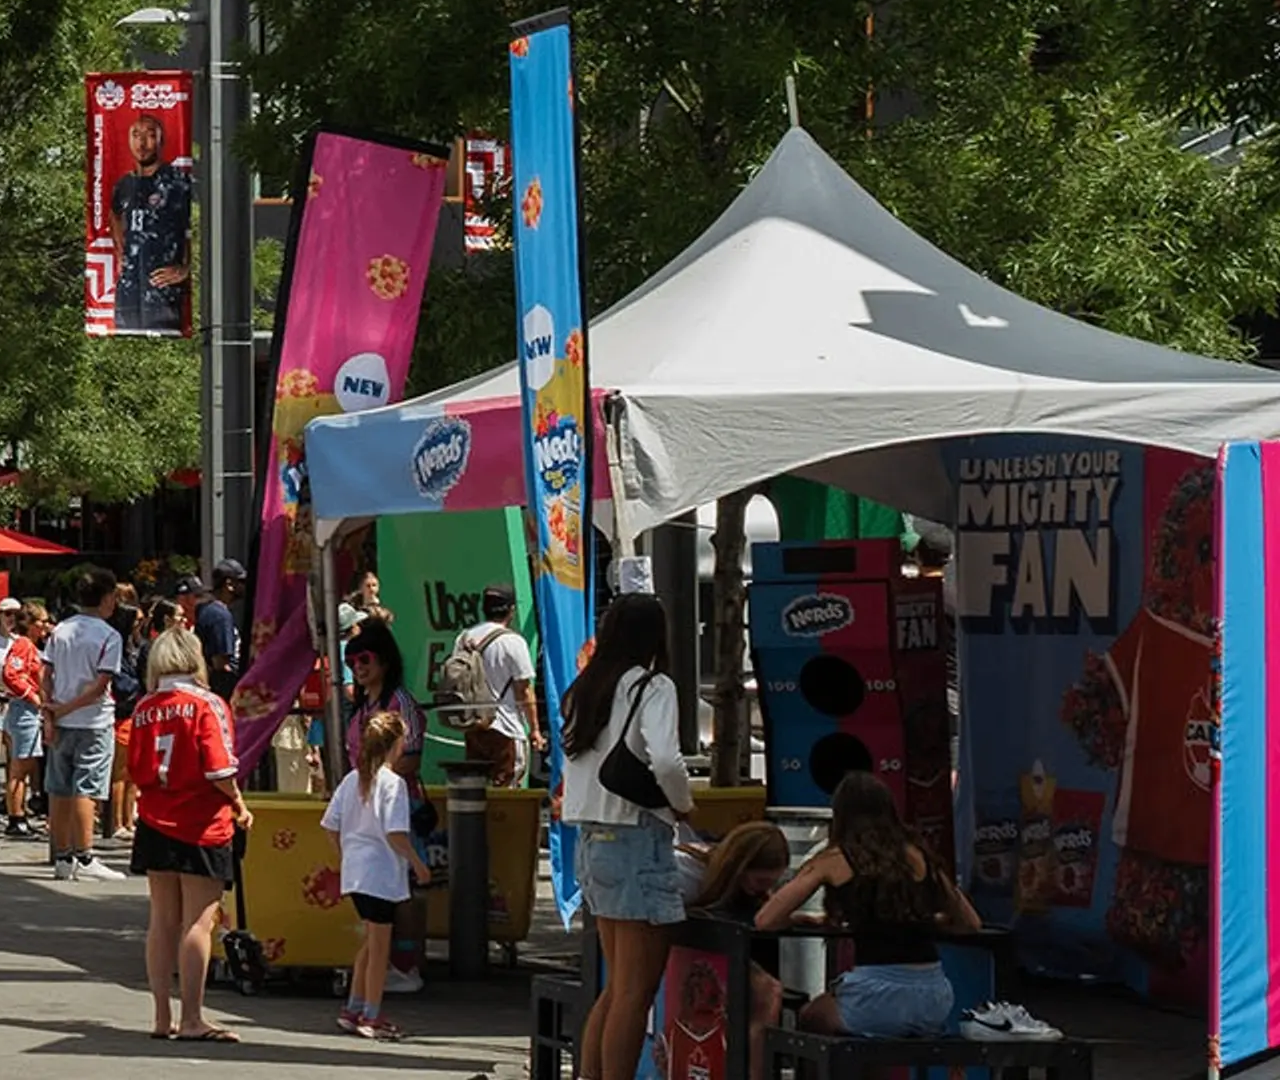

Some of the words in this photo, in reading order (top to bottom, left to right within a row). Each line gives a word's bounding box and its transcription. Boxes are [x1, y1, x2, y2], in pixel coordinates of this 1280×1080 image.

[93, 113, 104, 231] CORNELIUS
[131, 209, 144, 231] 13
[342, 376, 385, 398] NEW
[416, 433, 462, 480] Nerds
[960, 455, 1057, 481] UNLEASH
[1061, 450, 1121, 476] YOUR
[959, 476, 1119, 526] MIGHTY
[959, 527, 1110, 618] FAN
[424, 581, 481, 631] Uber
[791, 603, 844, 628] Nerds
[897, 619, 936, 650] FAN
[867, 679, 896, 690] 100
[135, 703, 195, 728] BECKHAM
[155, 733, 175, 788] 7
